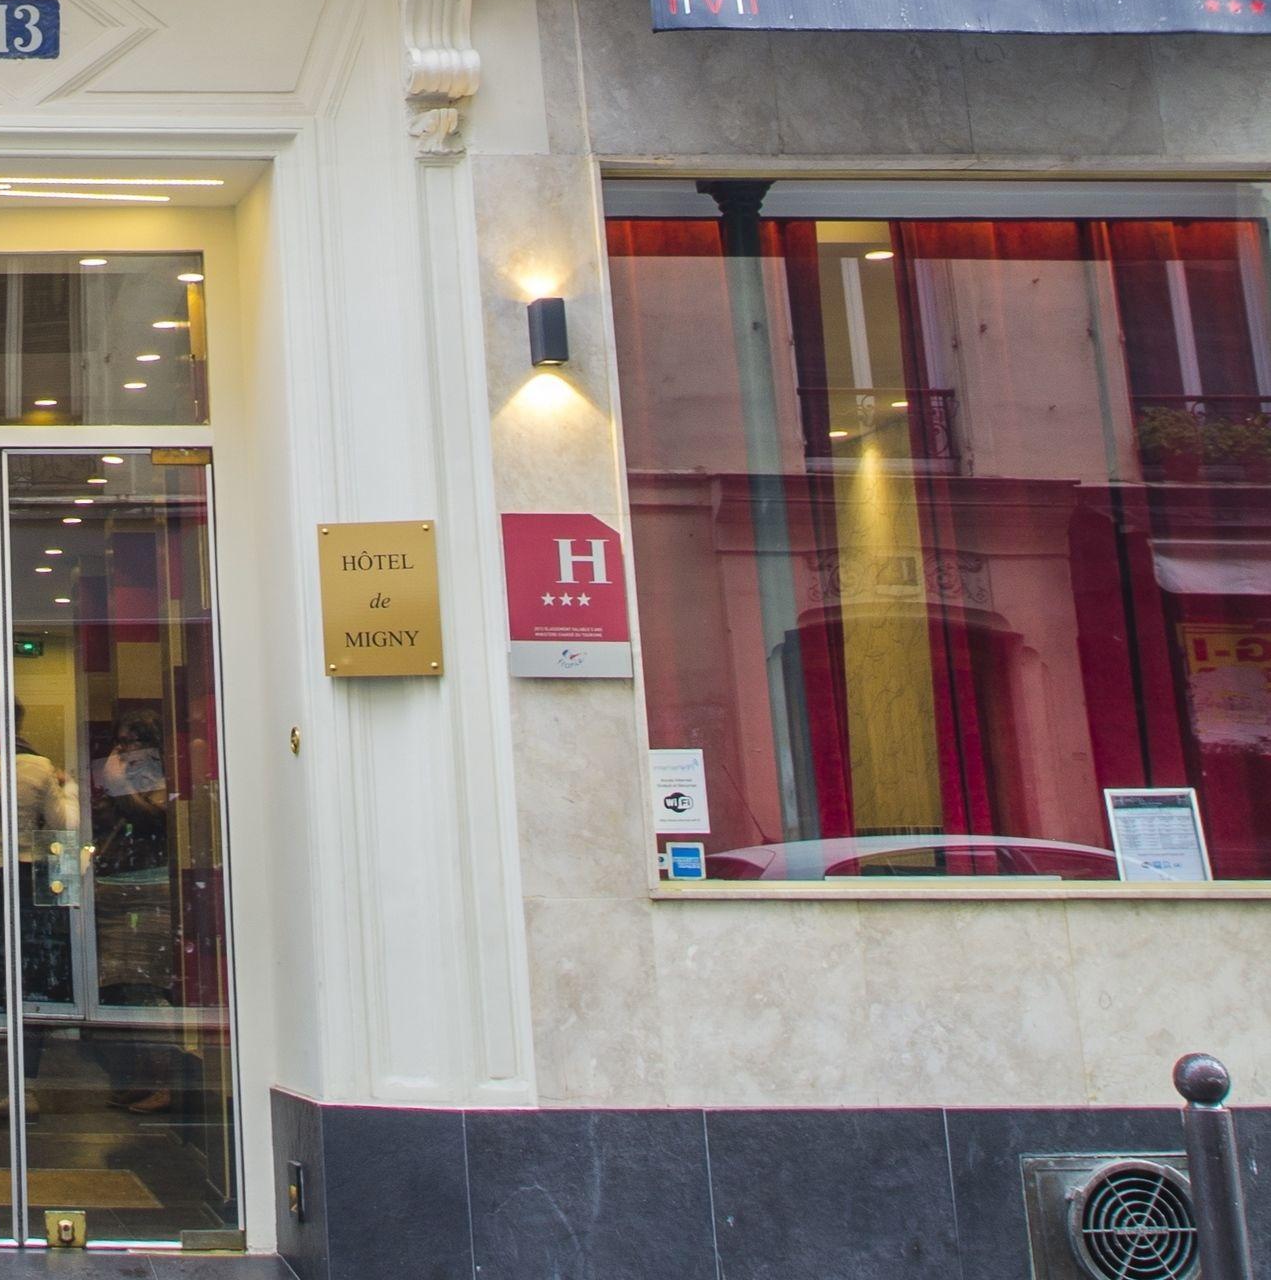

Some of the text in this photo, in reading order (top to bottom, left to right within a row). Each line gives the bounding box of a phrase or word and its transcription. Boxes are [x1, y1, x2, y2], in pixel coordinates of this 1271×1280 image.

[341, 550, 414, 571] HÔTEL
[553, 538, 612, 584] H
[369, 592, 391, 609] de
[345, 630, 420, 648] MIGNY
